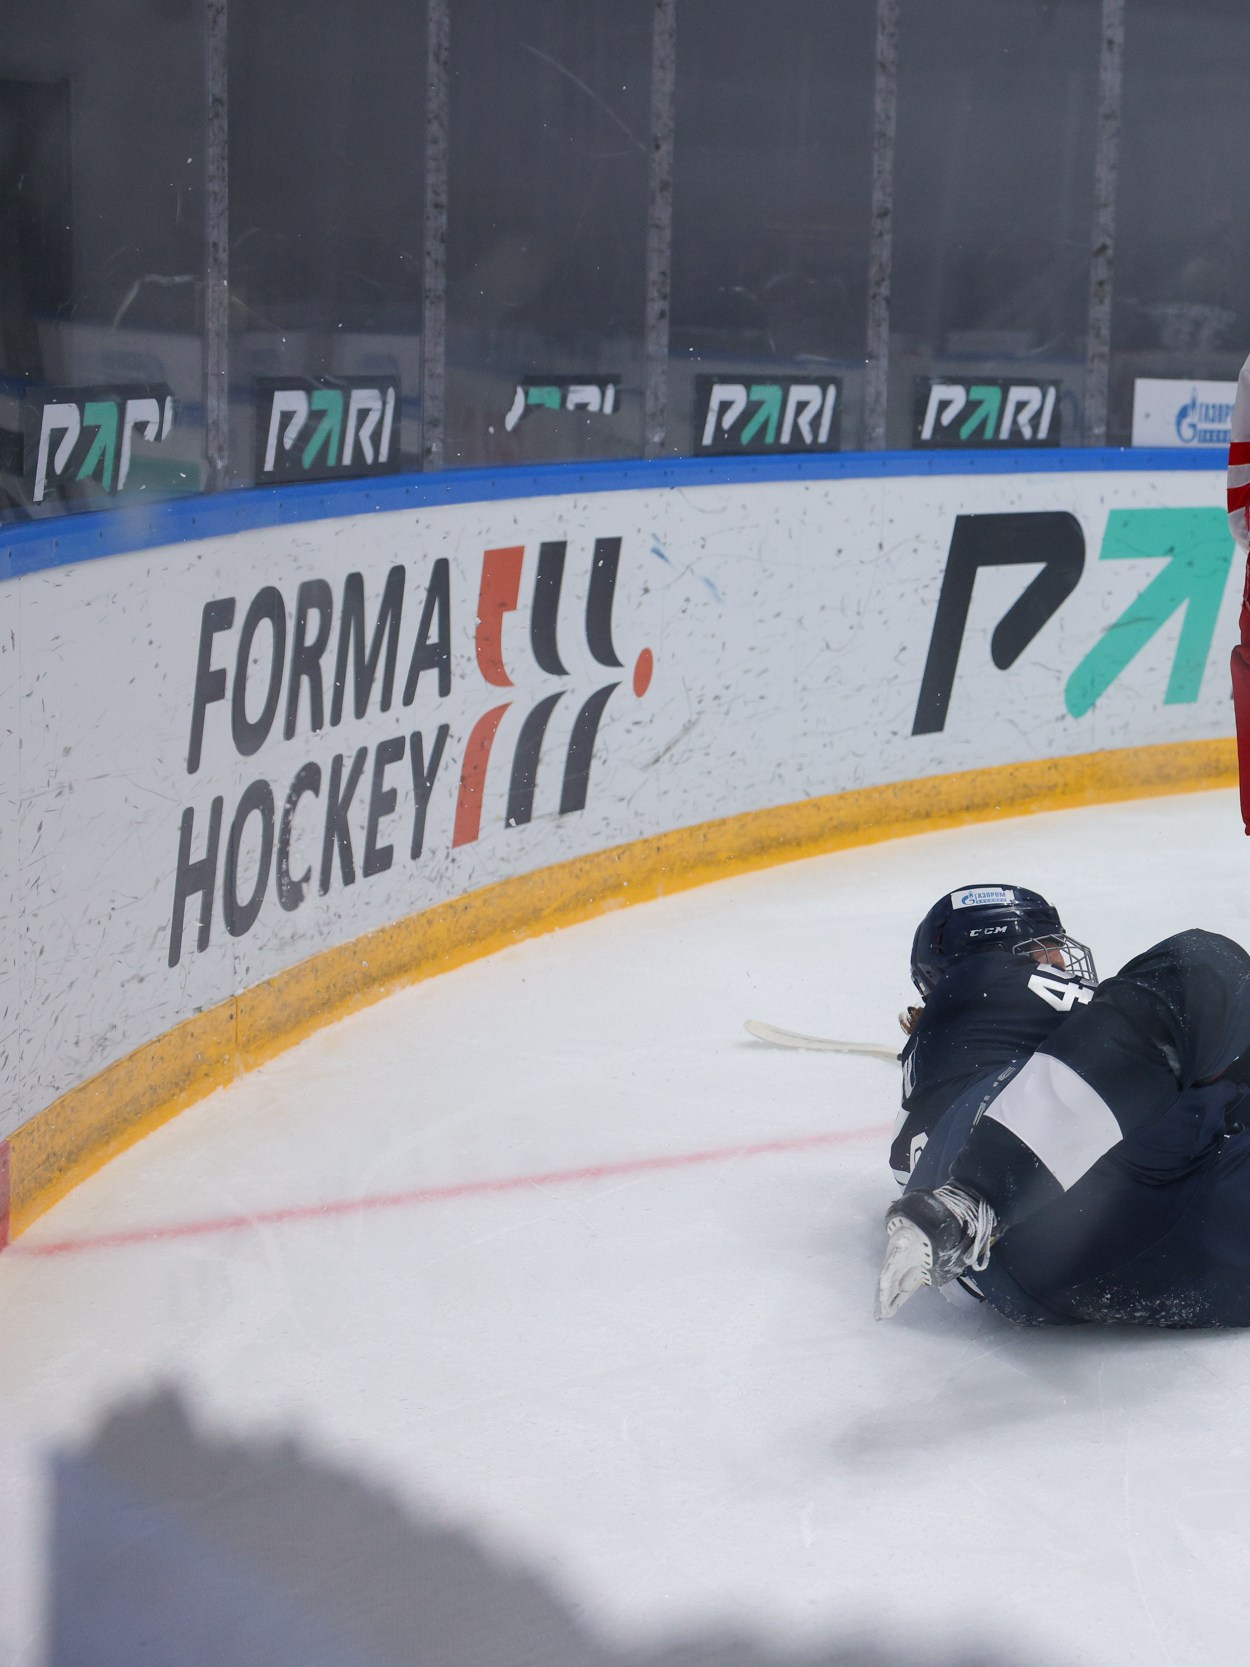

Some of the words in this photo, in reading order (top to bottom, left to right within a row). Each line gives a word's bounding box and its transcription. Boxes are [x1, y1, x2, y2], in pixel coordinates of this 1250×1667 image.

[263, 386, 395, 472] PARI
[701, 383, 837, 446] PARI
[920, 384, 1056, 440] PARI
[910, 505, 1236, 737] PA
[186, 557, 452, 774] FORMA
[167, 723, 450, 968] HOCKEY
[969, 925, 1008, 937] CCM
